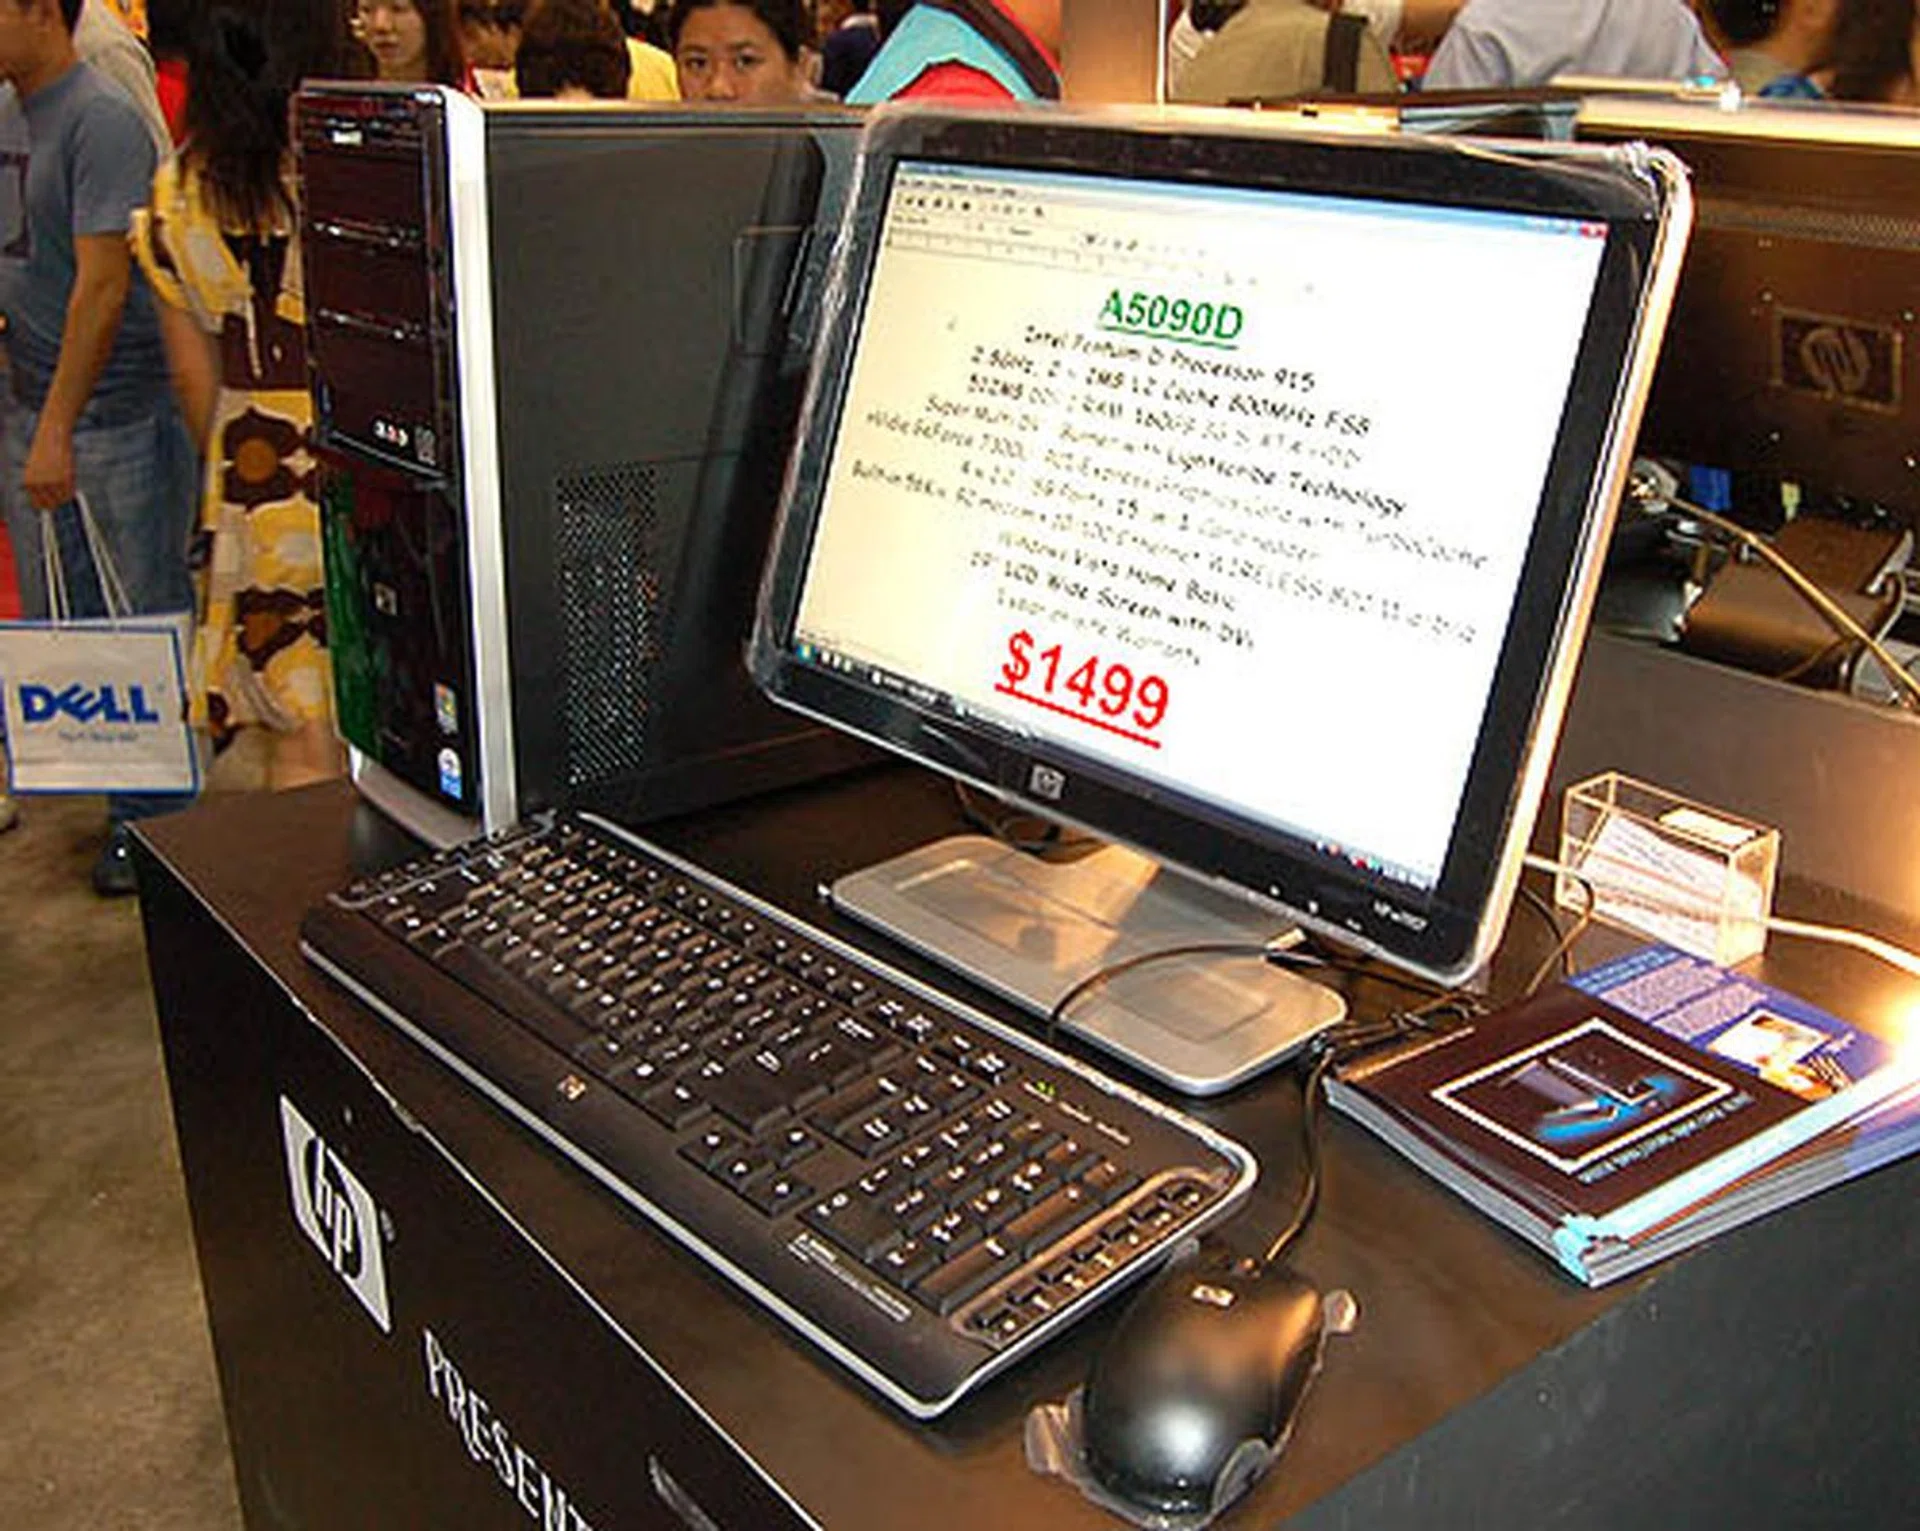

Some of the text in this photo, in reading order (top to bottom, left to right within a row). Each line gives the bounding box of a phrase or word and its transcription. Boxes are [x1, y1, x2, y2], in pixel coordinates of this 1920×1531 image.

[1097, 288, 1243, 342] A5090D
[1024, 323, 1067, 349] Intel
[1169, 348, 1267, 385] Processor
[1271, 366, 1317, 394] 915
[1161, 379, 1220, 410] Cache
[1322, 410, 1371, 440] FSB
[924, 393, 971, 420] Super
[1284, 471, 1410, 519] Technology
[1002, 557, 1041, 586] LCD
[1044, 569, 1090, 601] Wide
[1094, 583, 1164, 622] Screen
[1166, 604, 1214, 637] with
[1125, 563, 1178, 594] Home
[19, 683, 159, 722] DELL
[1001, 629, 1170, 730] $1499
[308, 1138, 355, 1274] hp
